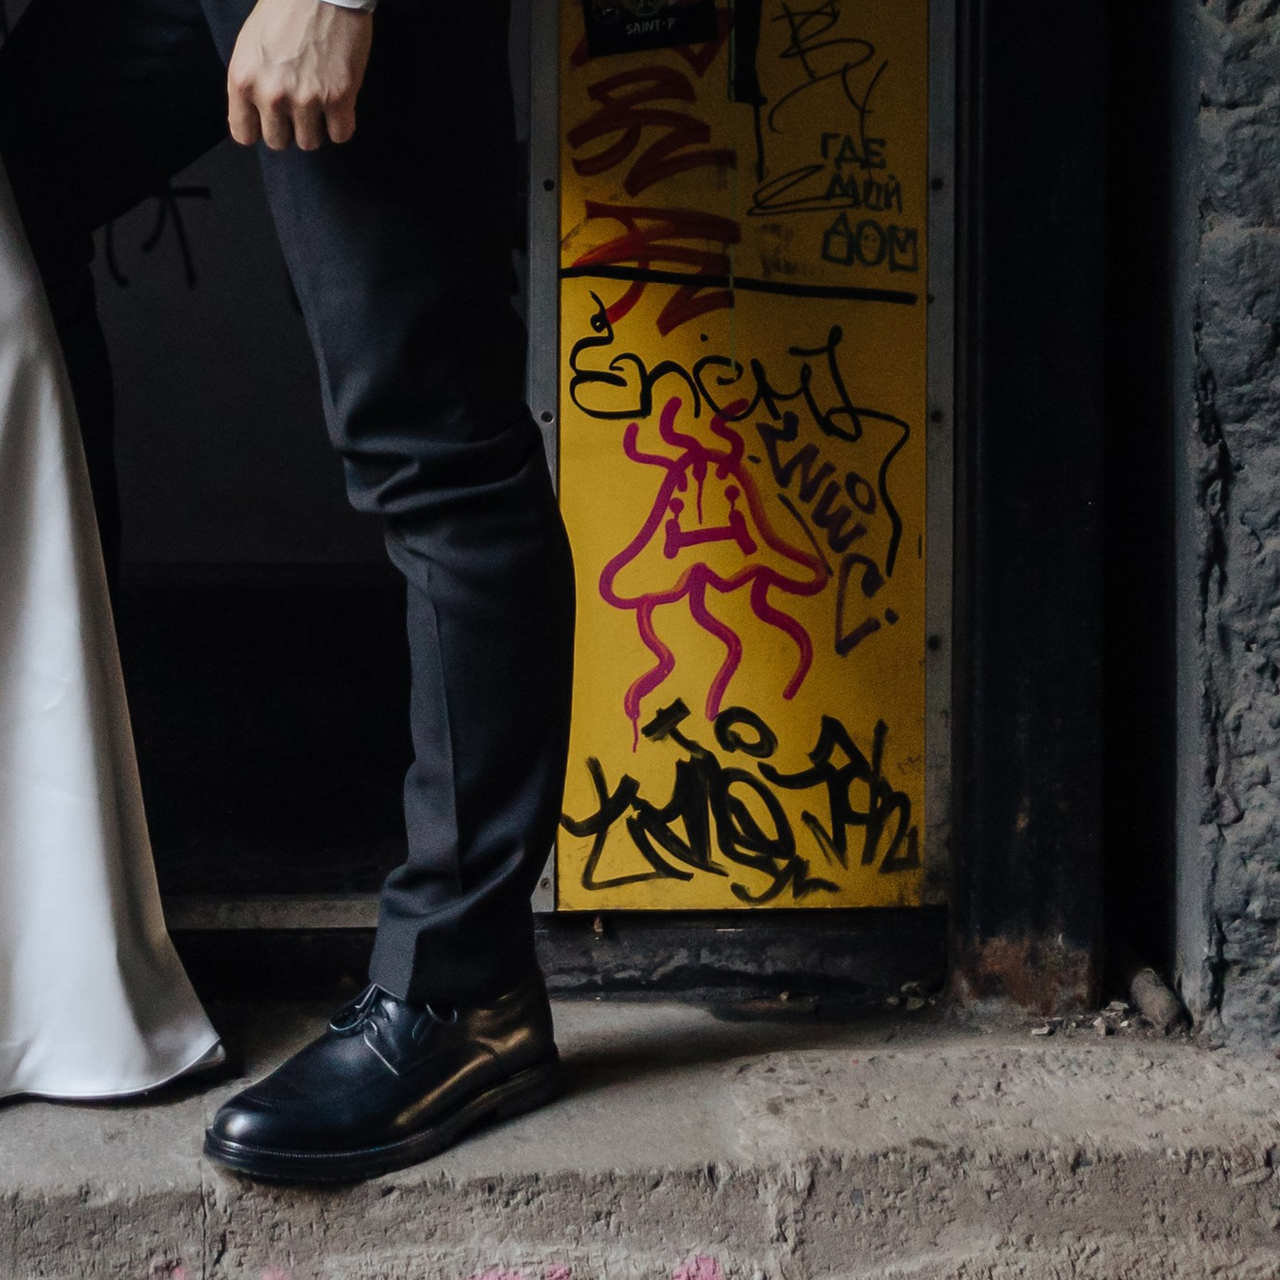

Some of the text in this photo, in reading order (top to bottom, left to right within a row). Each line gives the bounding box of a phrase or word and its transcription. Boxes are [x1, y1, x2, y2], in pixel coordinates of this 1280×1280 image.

[820, 132, 887, 170] ГДЕ
[825, 172, 904, 214] МОЙ
[820, 211, 919, 273] ДОМ
